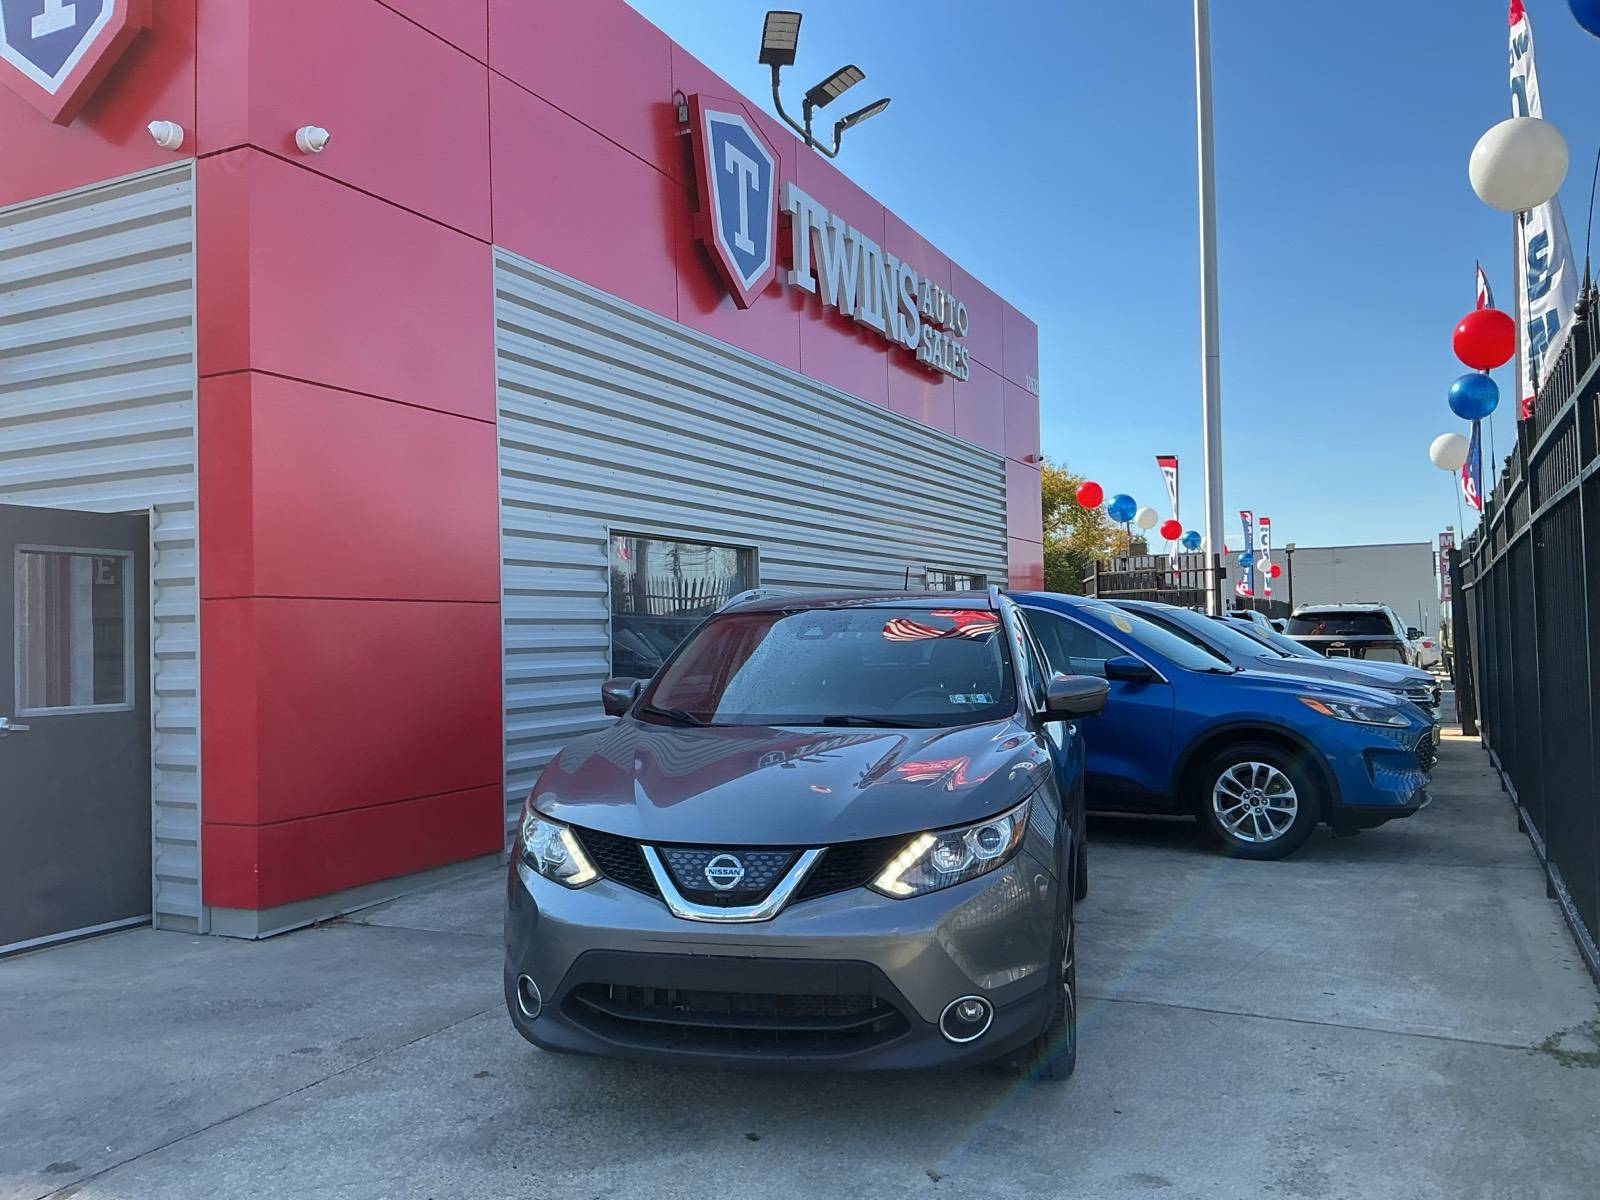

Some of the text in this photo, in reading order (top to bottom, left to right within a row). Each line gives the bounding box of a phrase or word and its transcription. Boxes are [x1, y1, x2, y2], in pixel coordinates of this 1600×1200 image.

[725, 140, 760, 256] T
[780, 181, 921, 350] TWINS
[920, 277, 969, 338] AUTO
[917, 323, 969, 382] SALES
